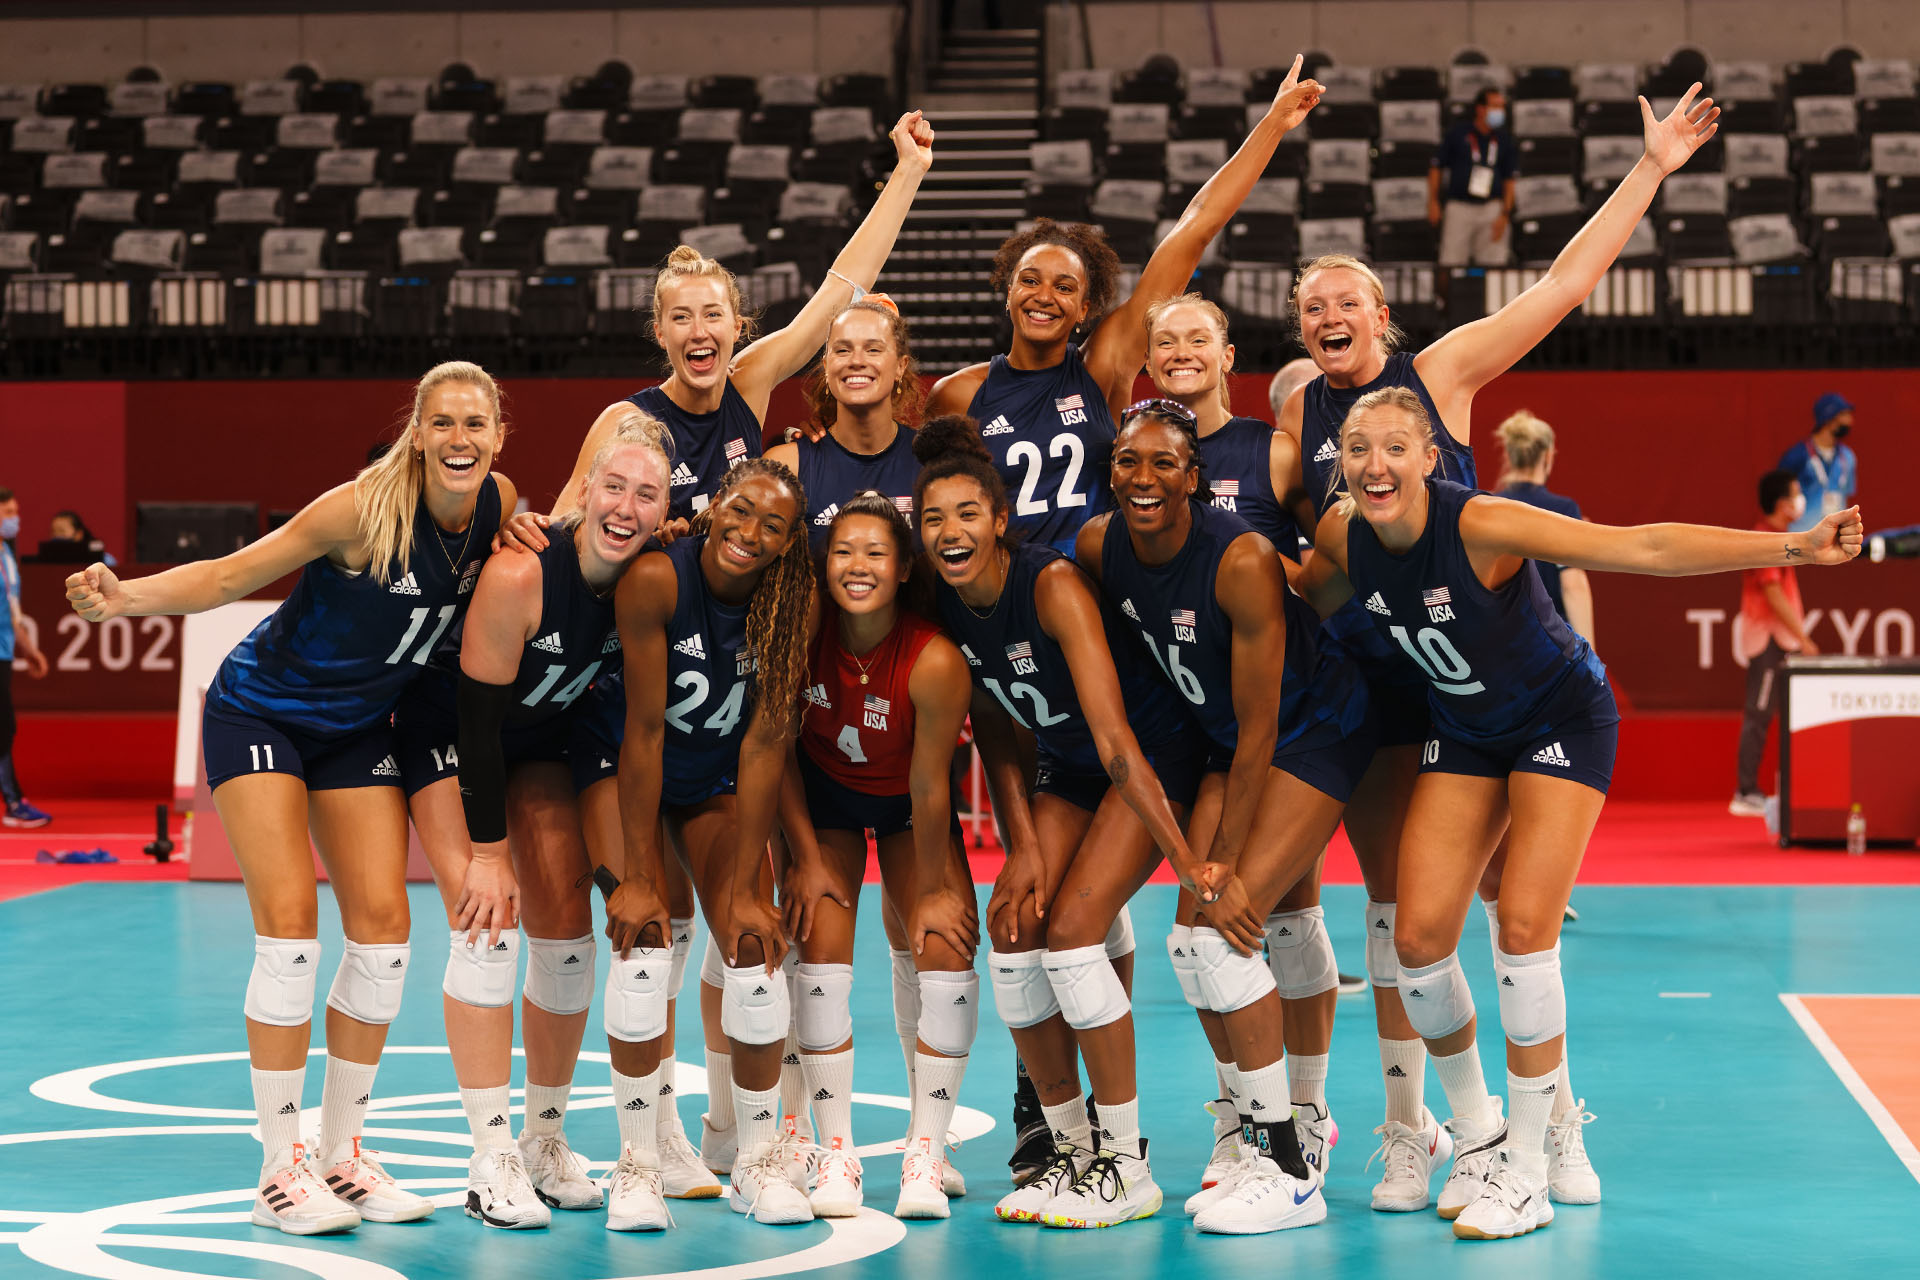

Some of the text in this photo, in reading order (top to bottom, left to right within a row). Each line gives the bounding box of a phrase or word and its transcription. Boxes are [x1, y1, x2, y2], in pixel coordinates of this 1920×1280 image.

[1060, 408, 1087, 426] USA
[982, 424, 1014, 437] adidas
[1313, 449, 1341, 462] adidas
[1006, 432, 1087, 516] 22
[1211, 496, 1236, 512] USA
[389, 585, 421, 596] adidas
[1365, 602, 1391, 616] adidas
[1427, 604, 1456, 624] USA
[385, 604, 457, 666] 11
[1174, 624, 1196, 644] USA
[531, 640, 564, 654] adidas
[673, 643, 706, 660] adidas
[1389, 625, 1472, 680] 10
[736, 657, 760, 676] USA
[1012, 657, 1039, 676] USA
[1142, 629, 1206, 705] 16
[521, 660, 602, 711] 14
[664, 670, 746, 737] 24
[801, 691, 832, 709] adidas
[982, 677, 1071, 729] 12
[1830, 692, 1893, 710] TOKYO
[863, 711, 888, 731] USA
[837, 724, 868, 763] 4
[1422, 739, 1440, 765] 10
[250, 744, 274, 770] 11
[431, 744, 458, 771] 14
[1532, 754, 1571, 767] adidas
[372, 767, 401, 776] adida
